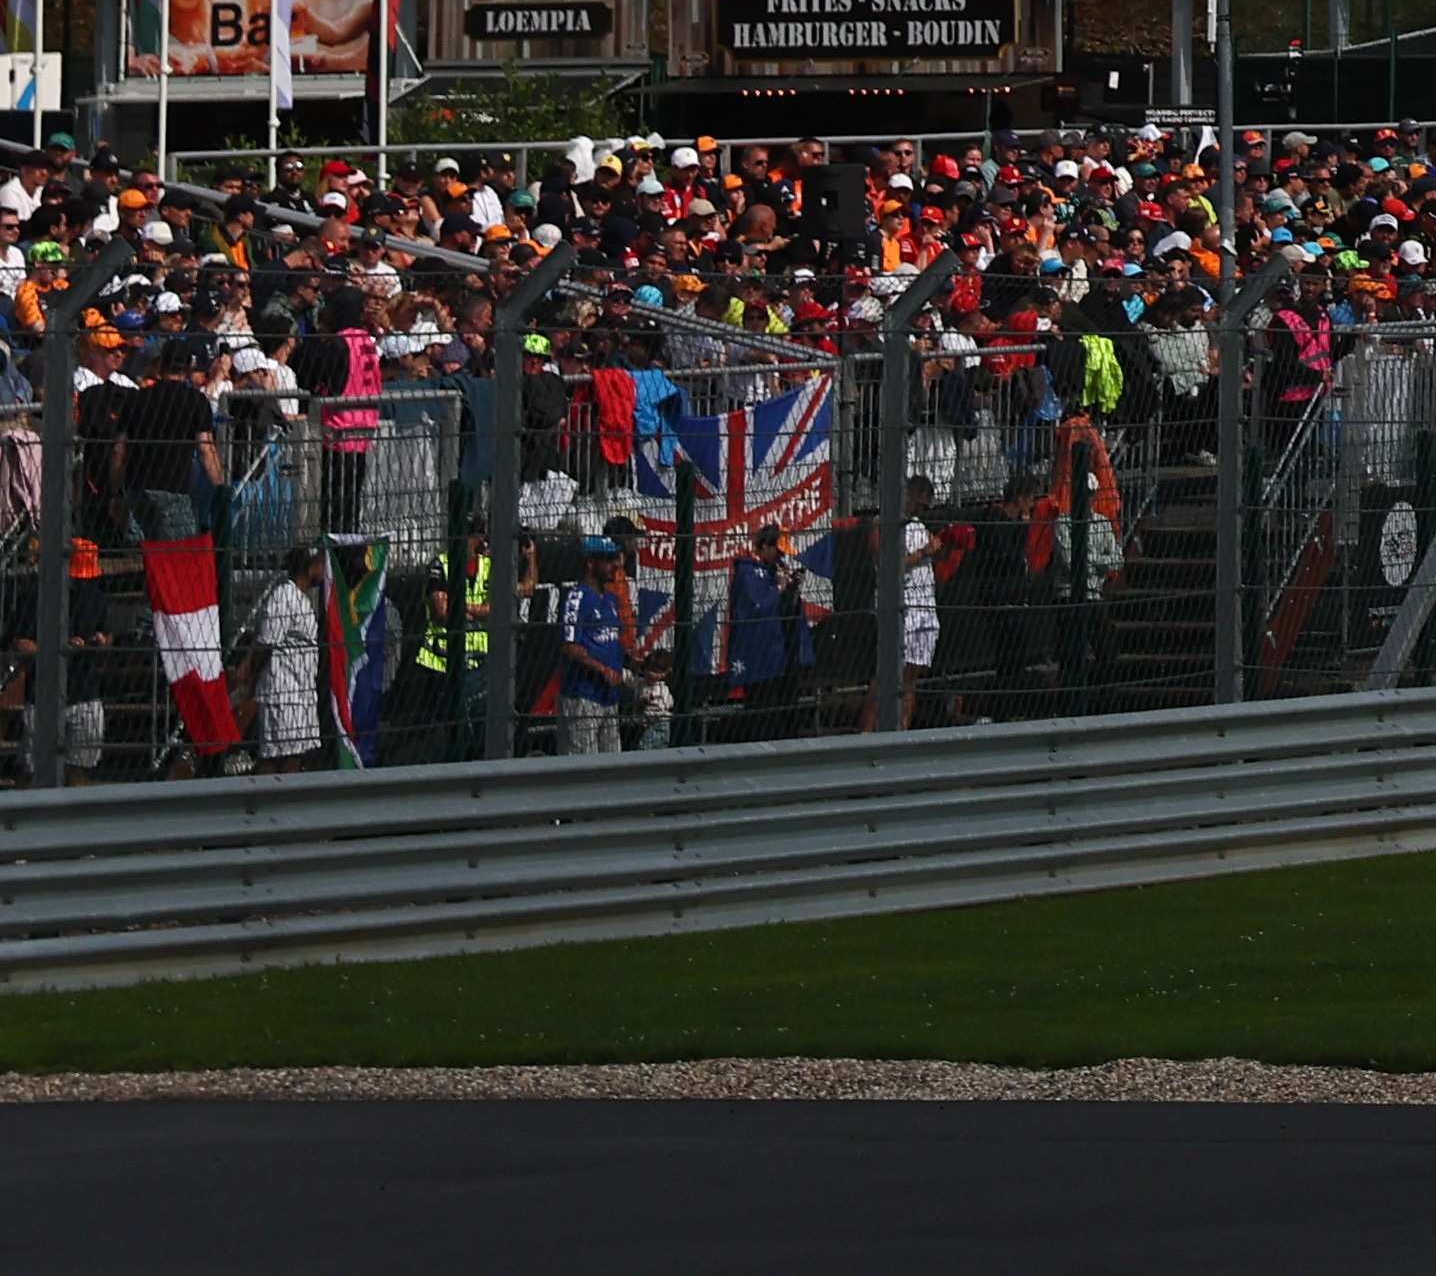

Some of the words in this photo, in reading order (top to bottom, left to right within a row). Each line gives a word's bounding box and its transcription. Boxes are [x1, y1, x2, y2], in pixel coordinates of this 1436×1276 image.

[485, 8, 593, 35] LOEMPIA
[733, 21, 887, 48] HAMBURGER
[907, 19, 1000, 46] BOUDIN
